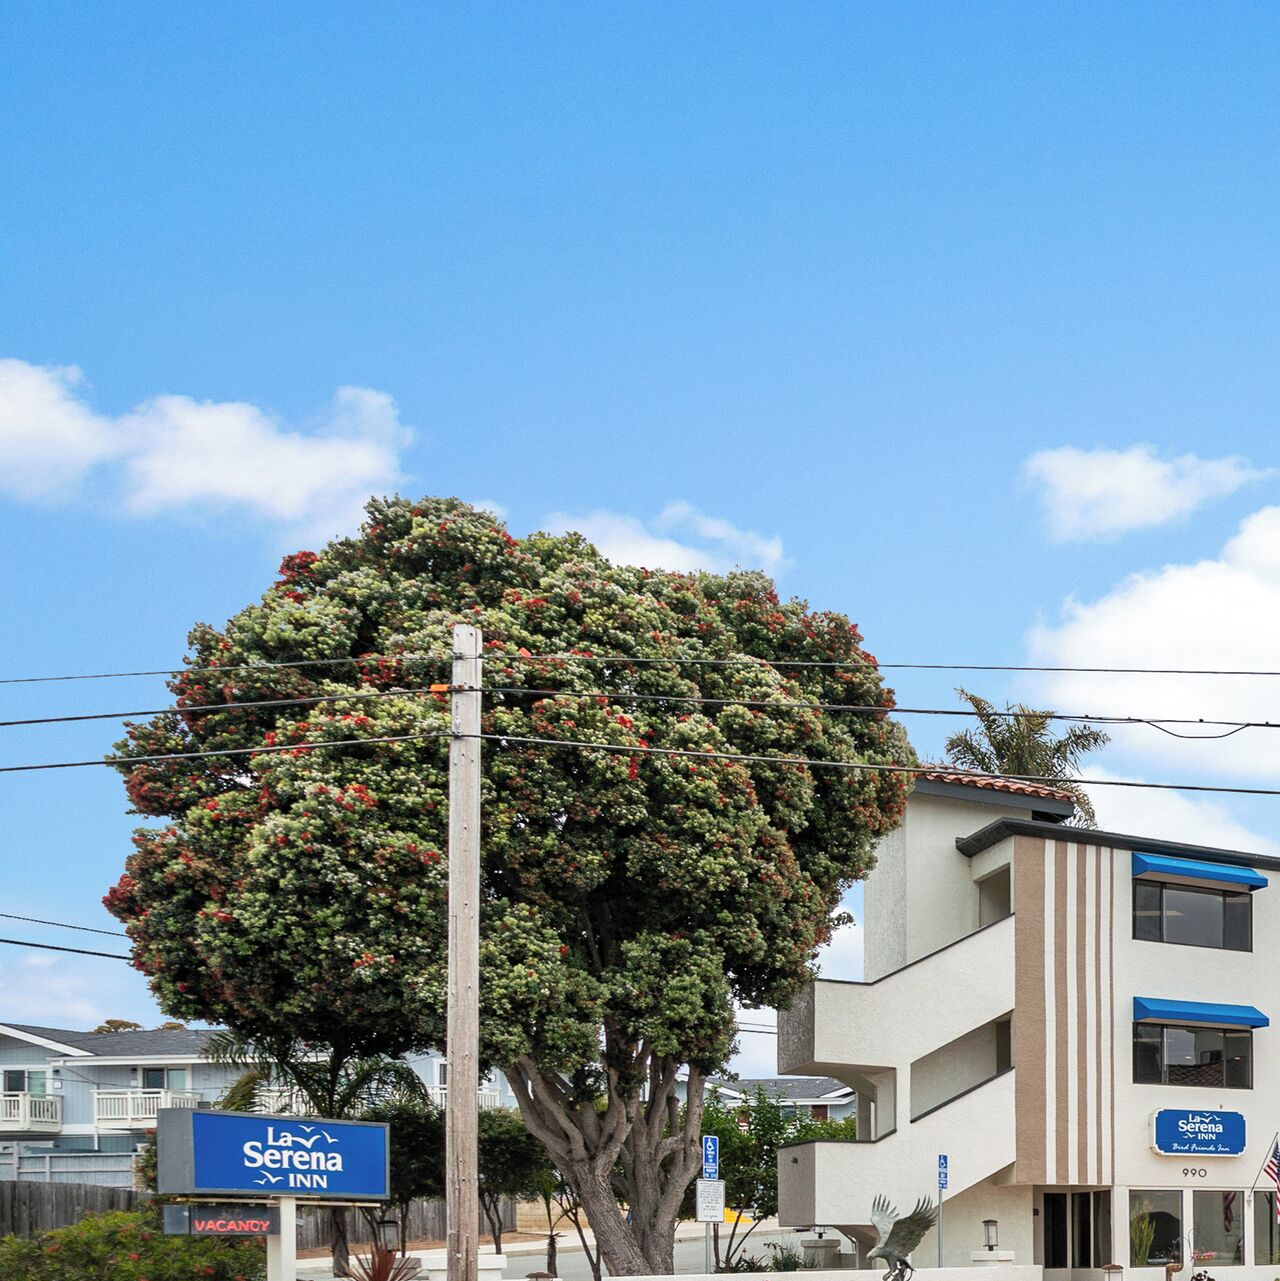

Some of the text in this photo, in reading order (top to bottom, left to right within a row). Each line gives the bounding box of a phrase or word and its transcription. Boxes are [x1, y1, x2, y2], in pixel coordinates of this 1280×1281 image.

[1188, 1113, 1201, 1123] La
[1178, 1120, 1224, 1133] Serena
[266, 1126, 293, 1147] La
[1172, 1143, 1190, 1151] Bird
[1217, 1144, 1231, 1152] Inn
[242, 1141, 344, 1171] Serena
[1182, 1168, 1208, 1178] 990
[288, 1173, 328, 1189] INN
[194, 1220, 271, 1232] VACANCY
